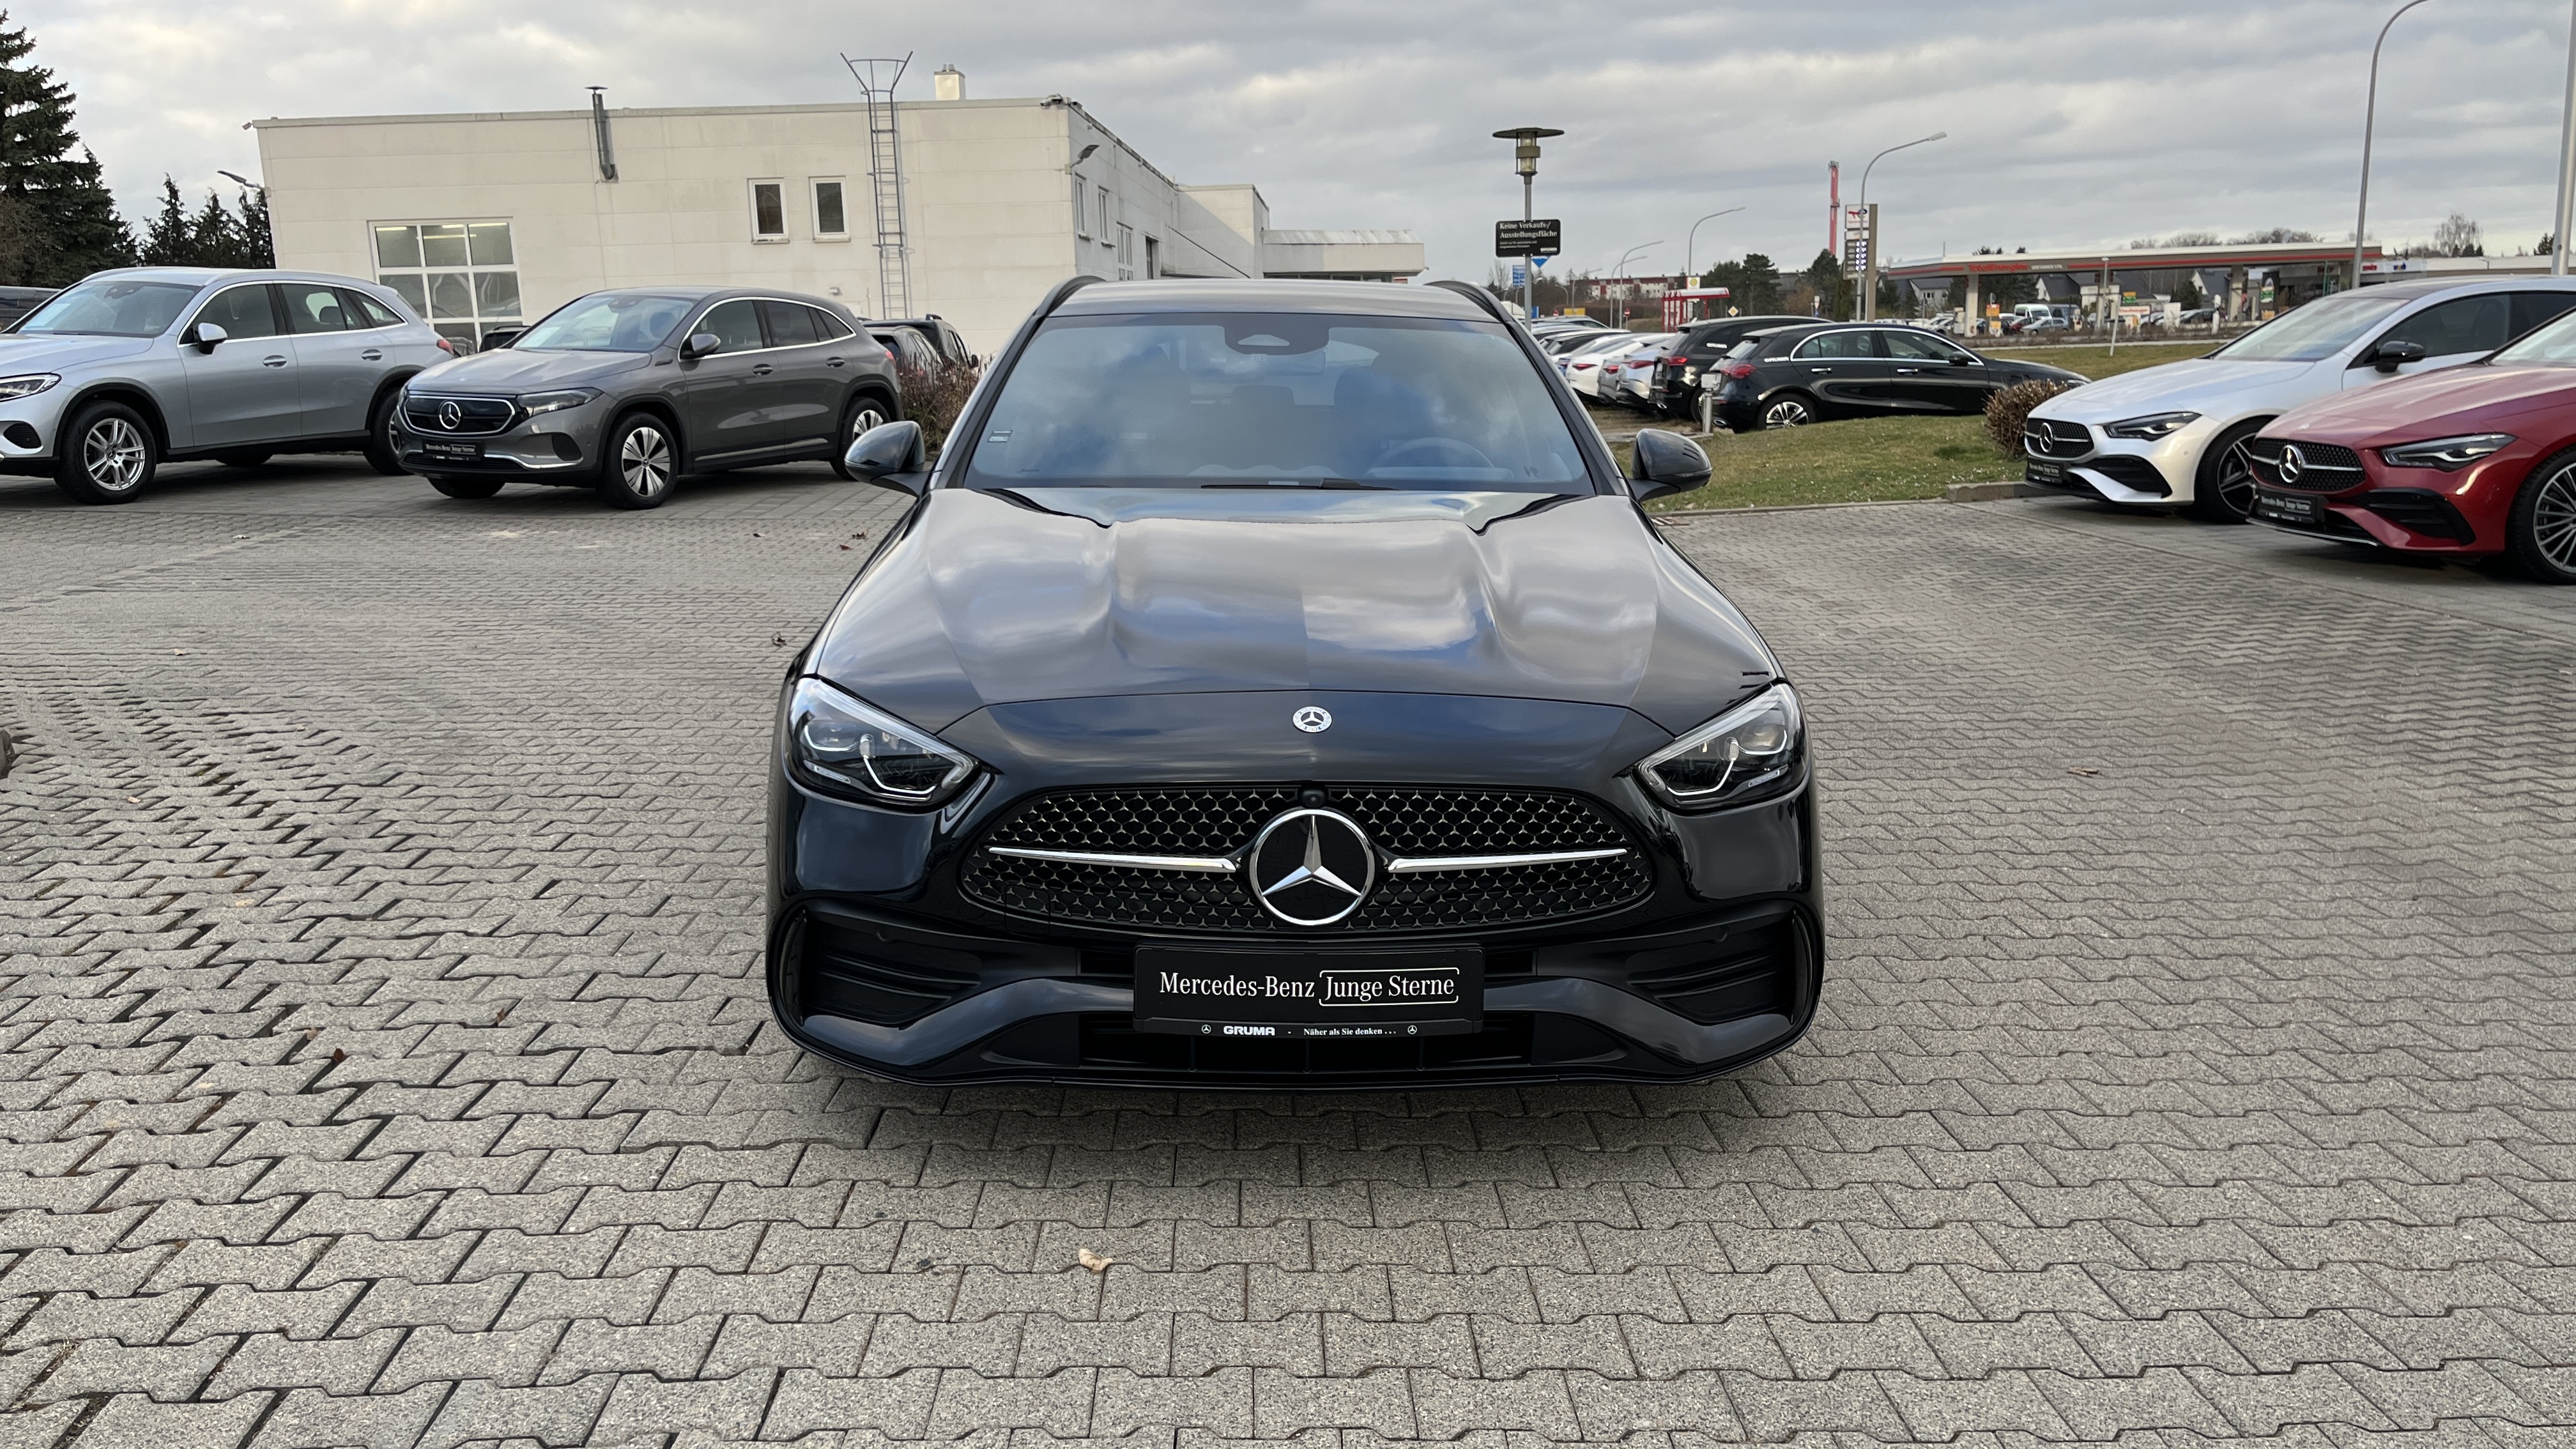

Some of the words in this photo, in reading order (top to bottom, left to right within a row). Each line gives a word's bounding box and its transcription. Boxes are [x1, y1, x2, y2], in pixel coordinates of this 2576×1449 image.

[1499, 231, 1558, 239] Ausstellungsfläche
[1160, 971, 1315, 998] Mercedes-Benz
[1324, 976, 1383, 1002] Junge
[1388, 975, 1454, 997] Sterne
[1223, 1025, 1275, 1036] GRUMA
[1341, 1027, 1354, 1036] Sie
